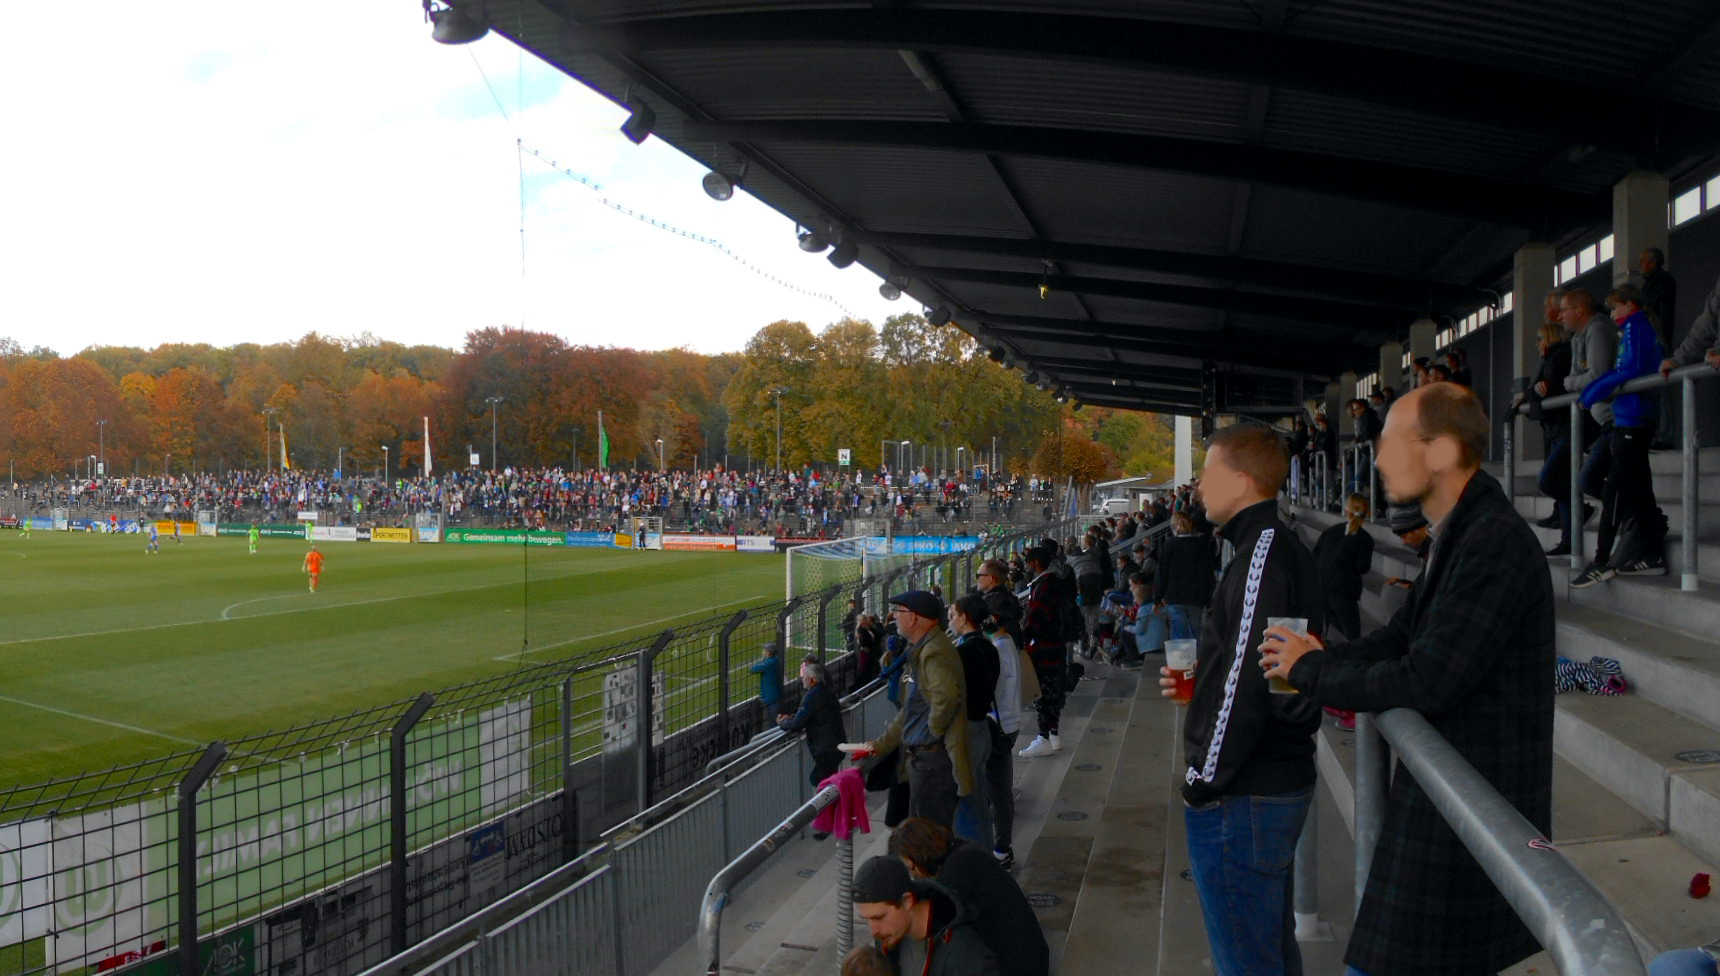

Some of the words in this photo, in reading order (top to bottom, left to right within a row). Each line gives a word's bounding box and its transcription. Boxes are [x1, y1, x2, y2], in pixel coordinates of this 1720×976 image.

[463, 533, 505, 541] Gemeinsam
[507, 535, 526, 543] mehr
[527, 534, 564, 546] bewegen.
